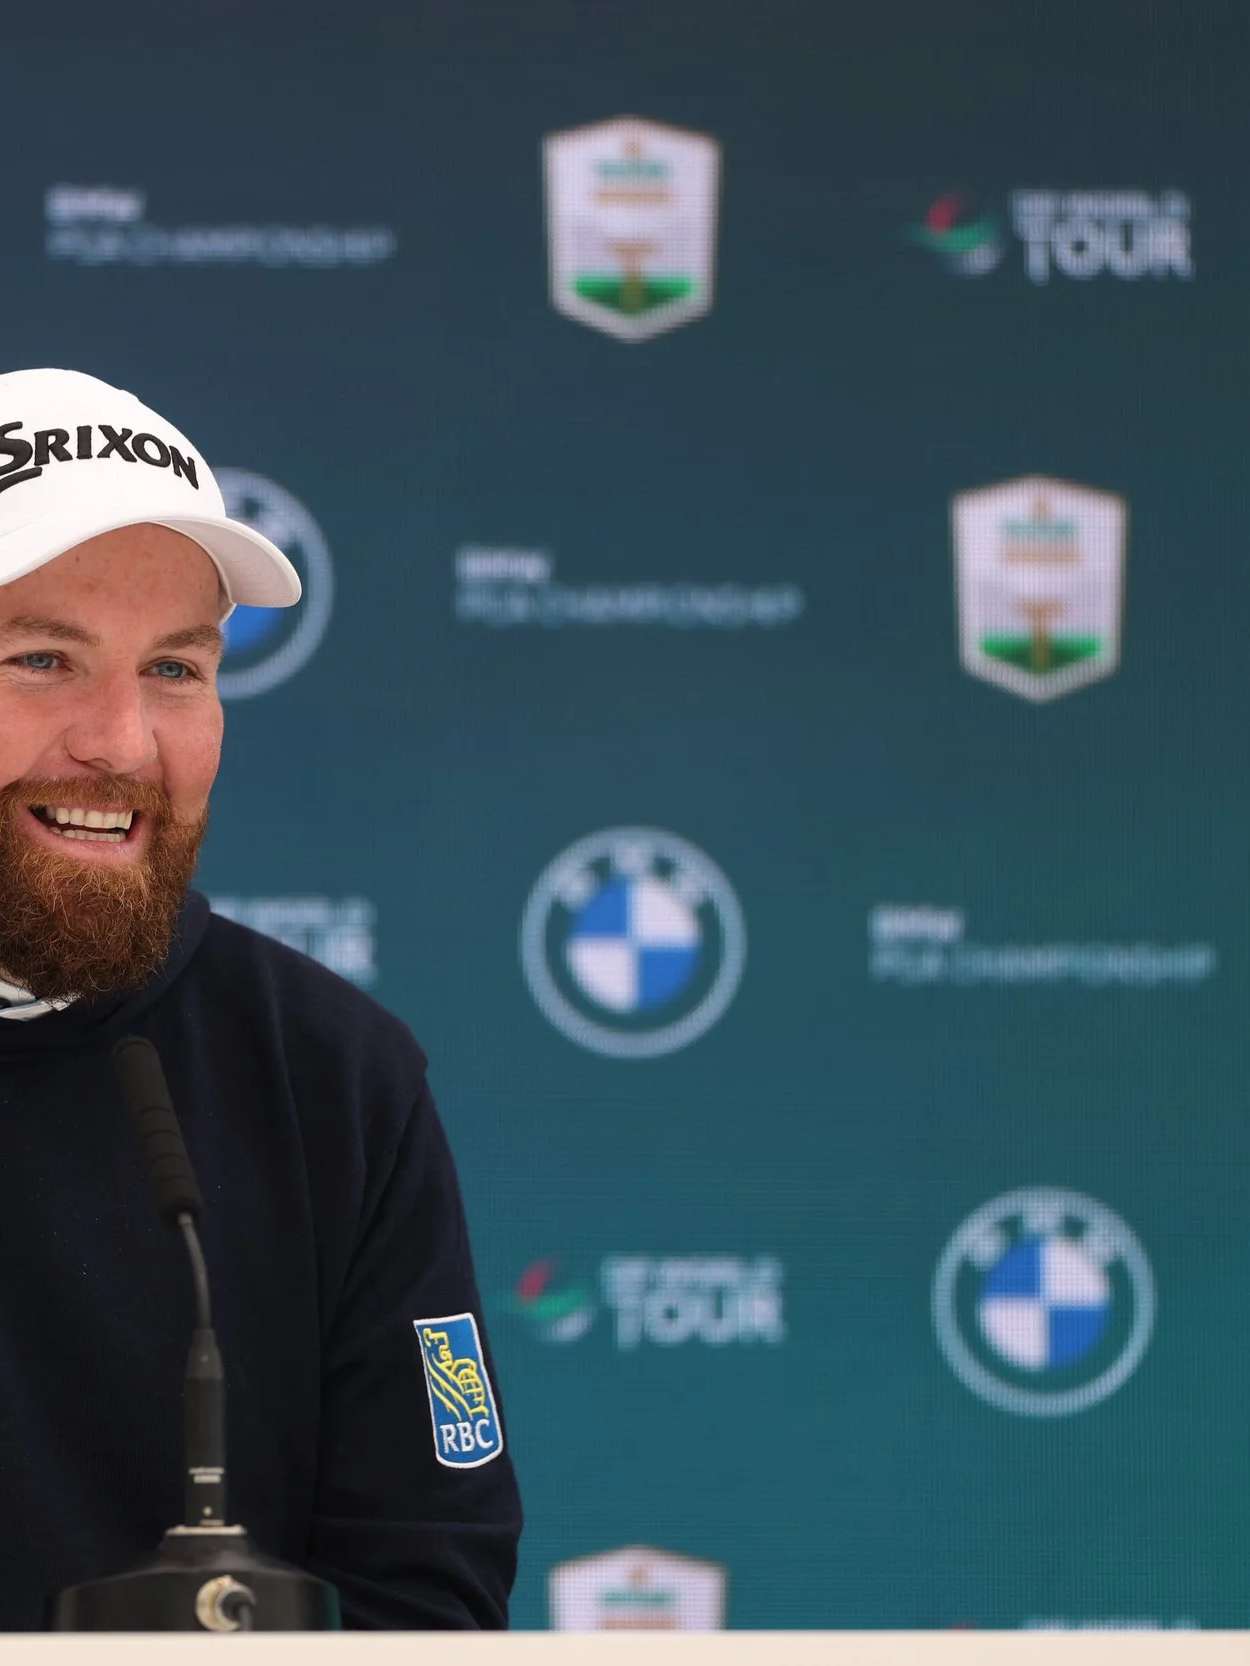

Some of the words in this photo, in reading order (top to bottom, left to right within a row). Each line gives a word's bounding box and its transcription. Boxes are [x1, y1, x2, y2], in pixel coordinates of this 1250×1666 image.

[1018, 216, 1193, 283] TOUR
[608, 1290, 785, 1349] TOUR
[440, 1419, 493, 1453] RBC
